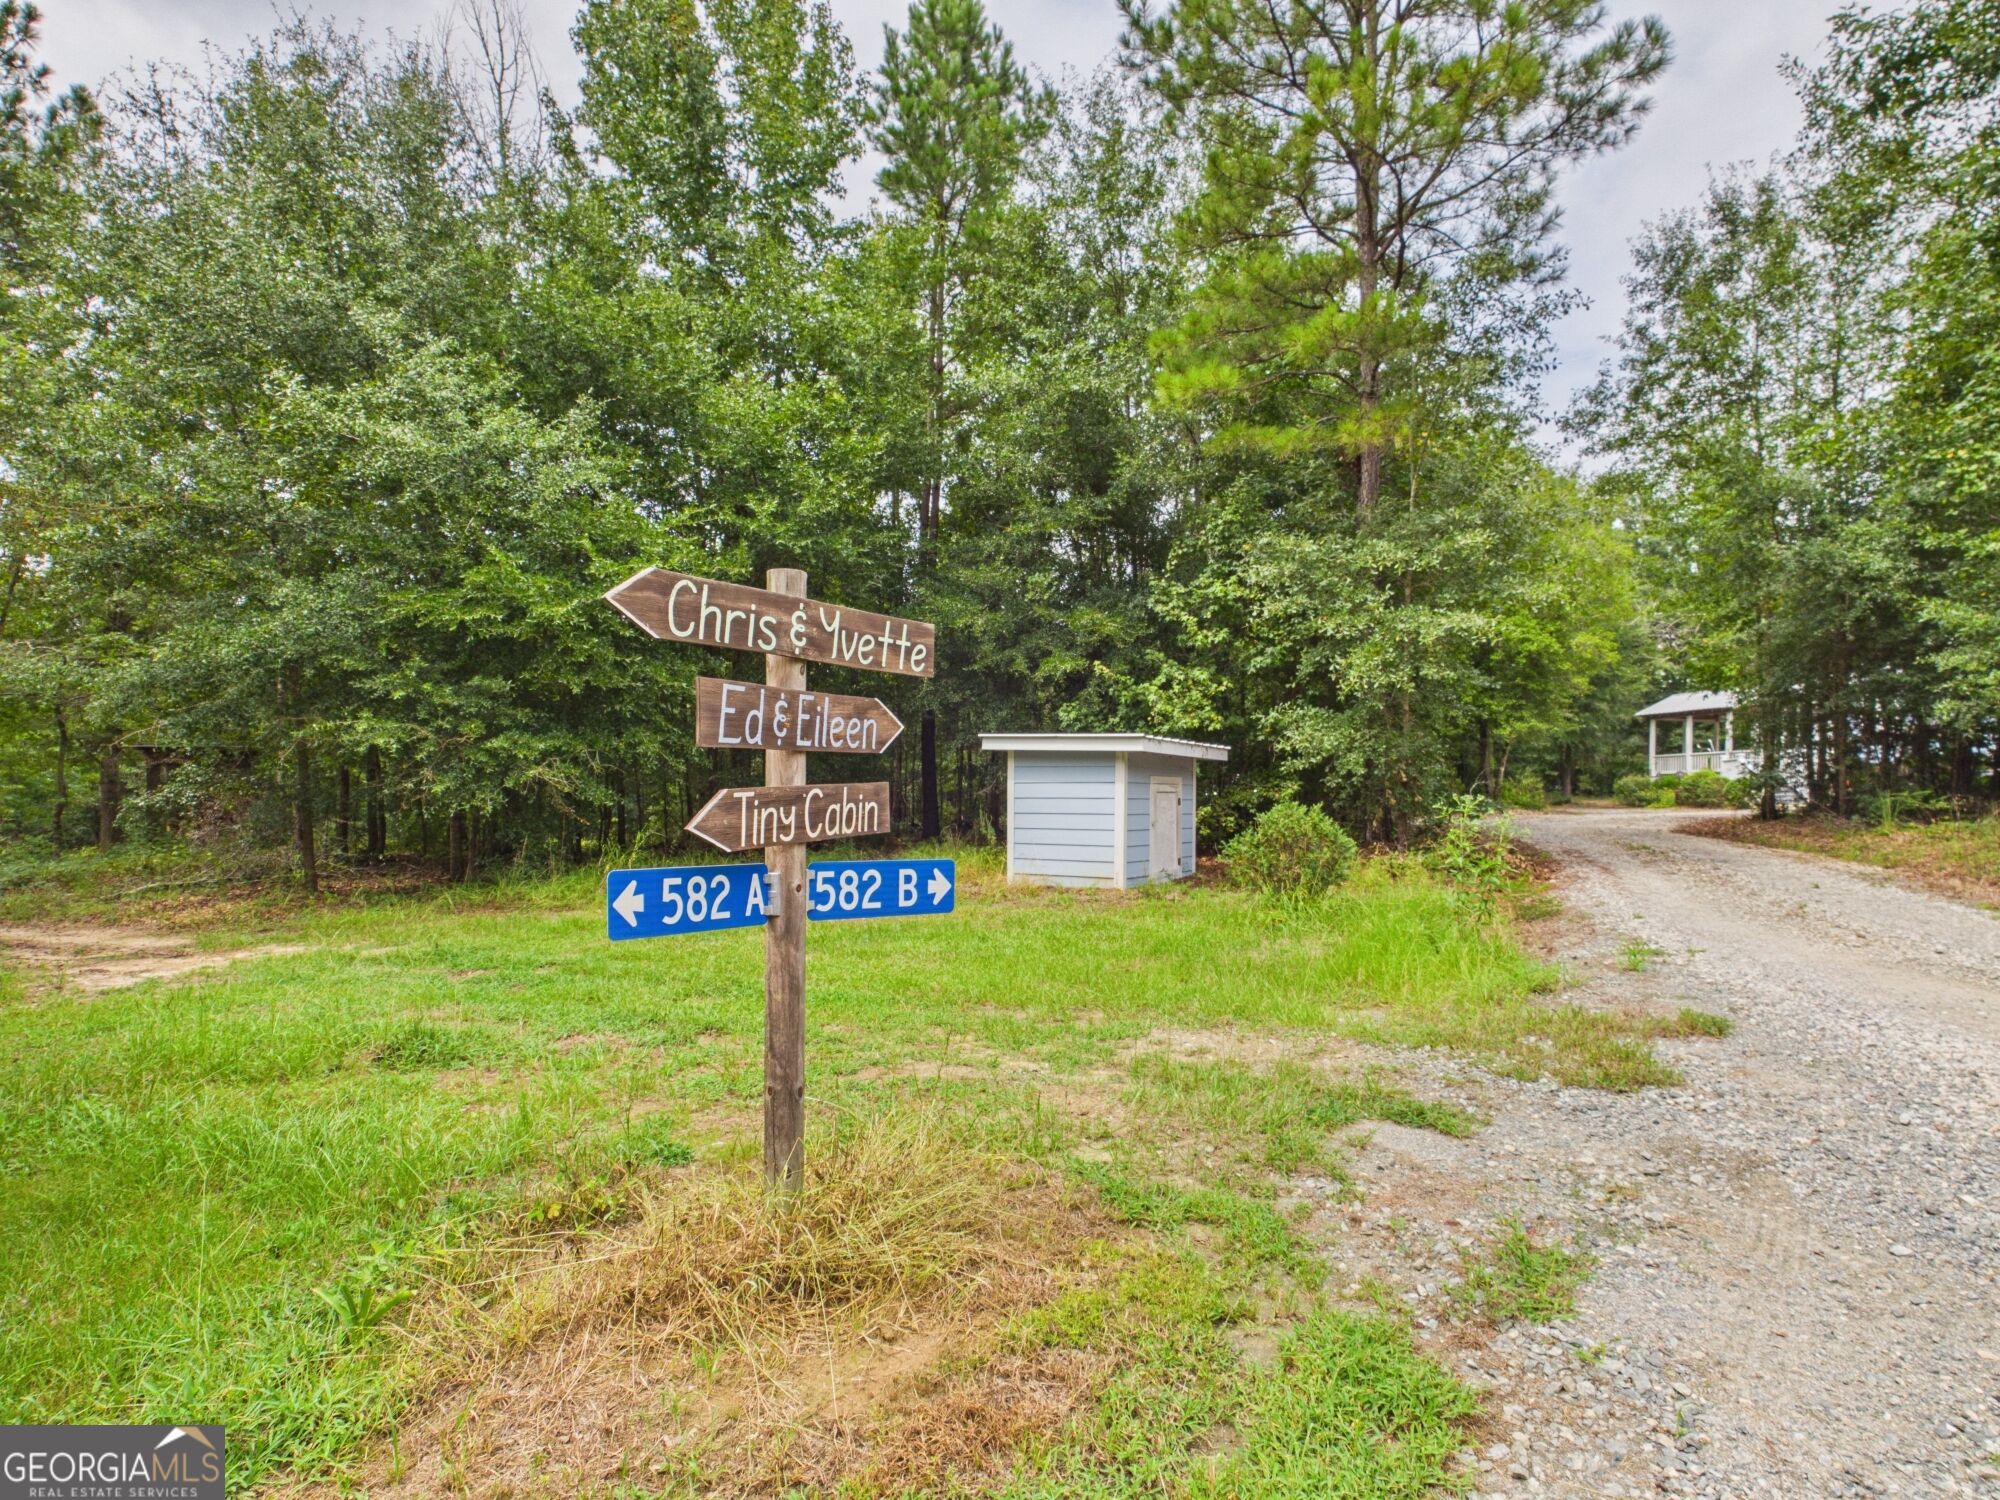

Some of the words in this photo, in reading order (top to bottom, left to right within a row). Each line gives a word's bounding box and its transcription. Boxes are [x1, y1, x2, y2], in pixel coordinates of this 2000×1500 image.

[667, 579, 777, 651] Chris
[790, 603, 807, 655] &
[819, 607, 927, 673] Yvette
[718, 683, 764, 746] Ed
[773, 692, 788, 746] &
[796, 694, 877, 750] Eileen
[733, 791, 796, 847] Tiny
[803, 788, 879, 839] Cabin
[662, 874, 731, 925] 582
[745, 873, 766, 916] A
[815, 868, 882, 913] 582
[898, 868, 918, 907] B
